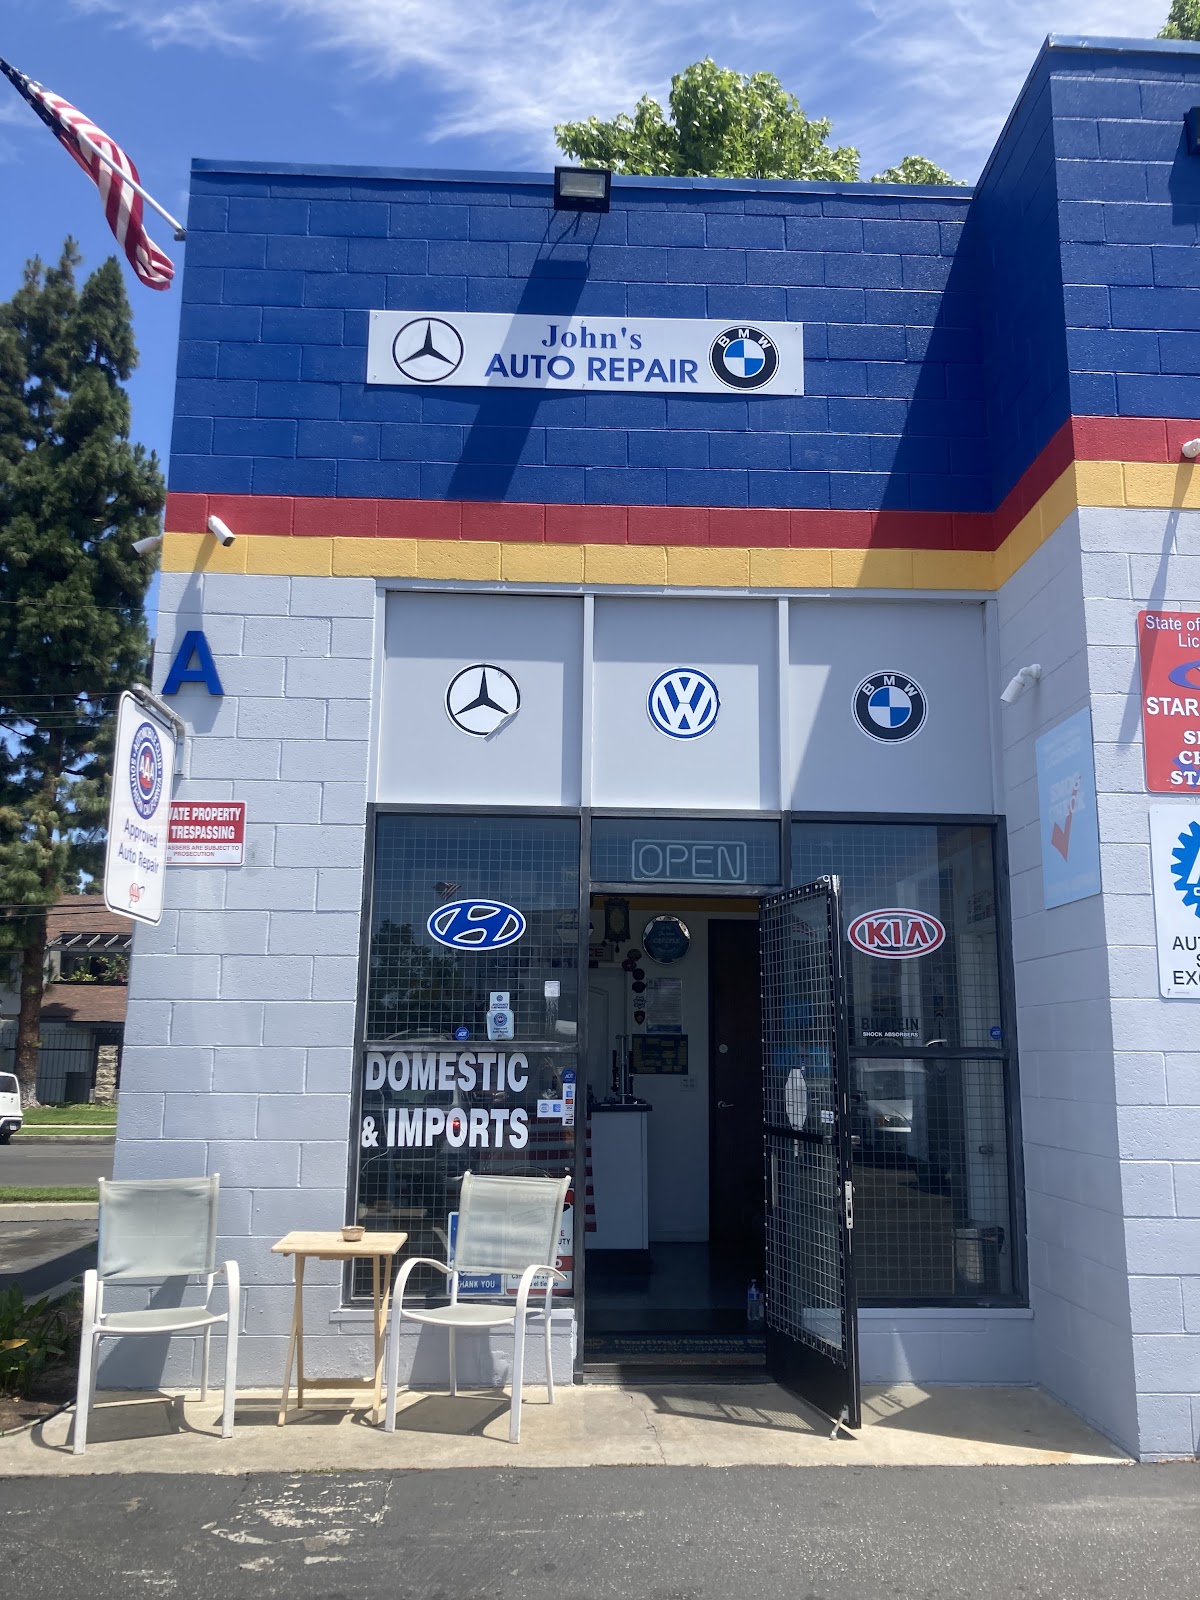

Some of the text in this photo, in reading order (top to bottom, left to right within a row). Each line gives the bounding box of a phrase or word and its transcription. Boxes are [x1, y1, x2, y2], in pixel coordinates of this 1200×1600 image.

[541, 324, 642, 351] John's
[717, 328, 771, 350] BMW
[484, 353, 699, 383] AUTO REPAIR
[1145, 614, 1200, 631] State of
[161, 630, 225, 695] A
[862, 675, 918, 697] BMW
[1146, 696, 1200, 716] STAR
[140, 755, 154, 781] AAA
[192, 807, 242, 821] PROPERTY
[123, 817, 159, 848] Approved
[171, 825, 235, 839] TRESPASSING
[117, 842, 159, 873] Auto Repair
[638, 844, 741, 878] OPEN
[864, 919, 932, 947] KIA
[1172, 935, 1200, 951] AU
[1173, 970, 1200, 986] EX
[365, 1051, 529, 1092] DOMESTIC
[361, 1107, 529, 1149] & IMPORTS
[480, 1280, 496, 1289] YOU
